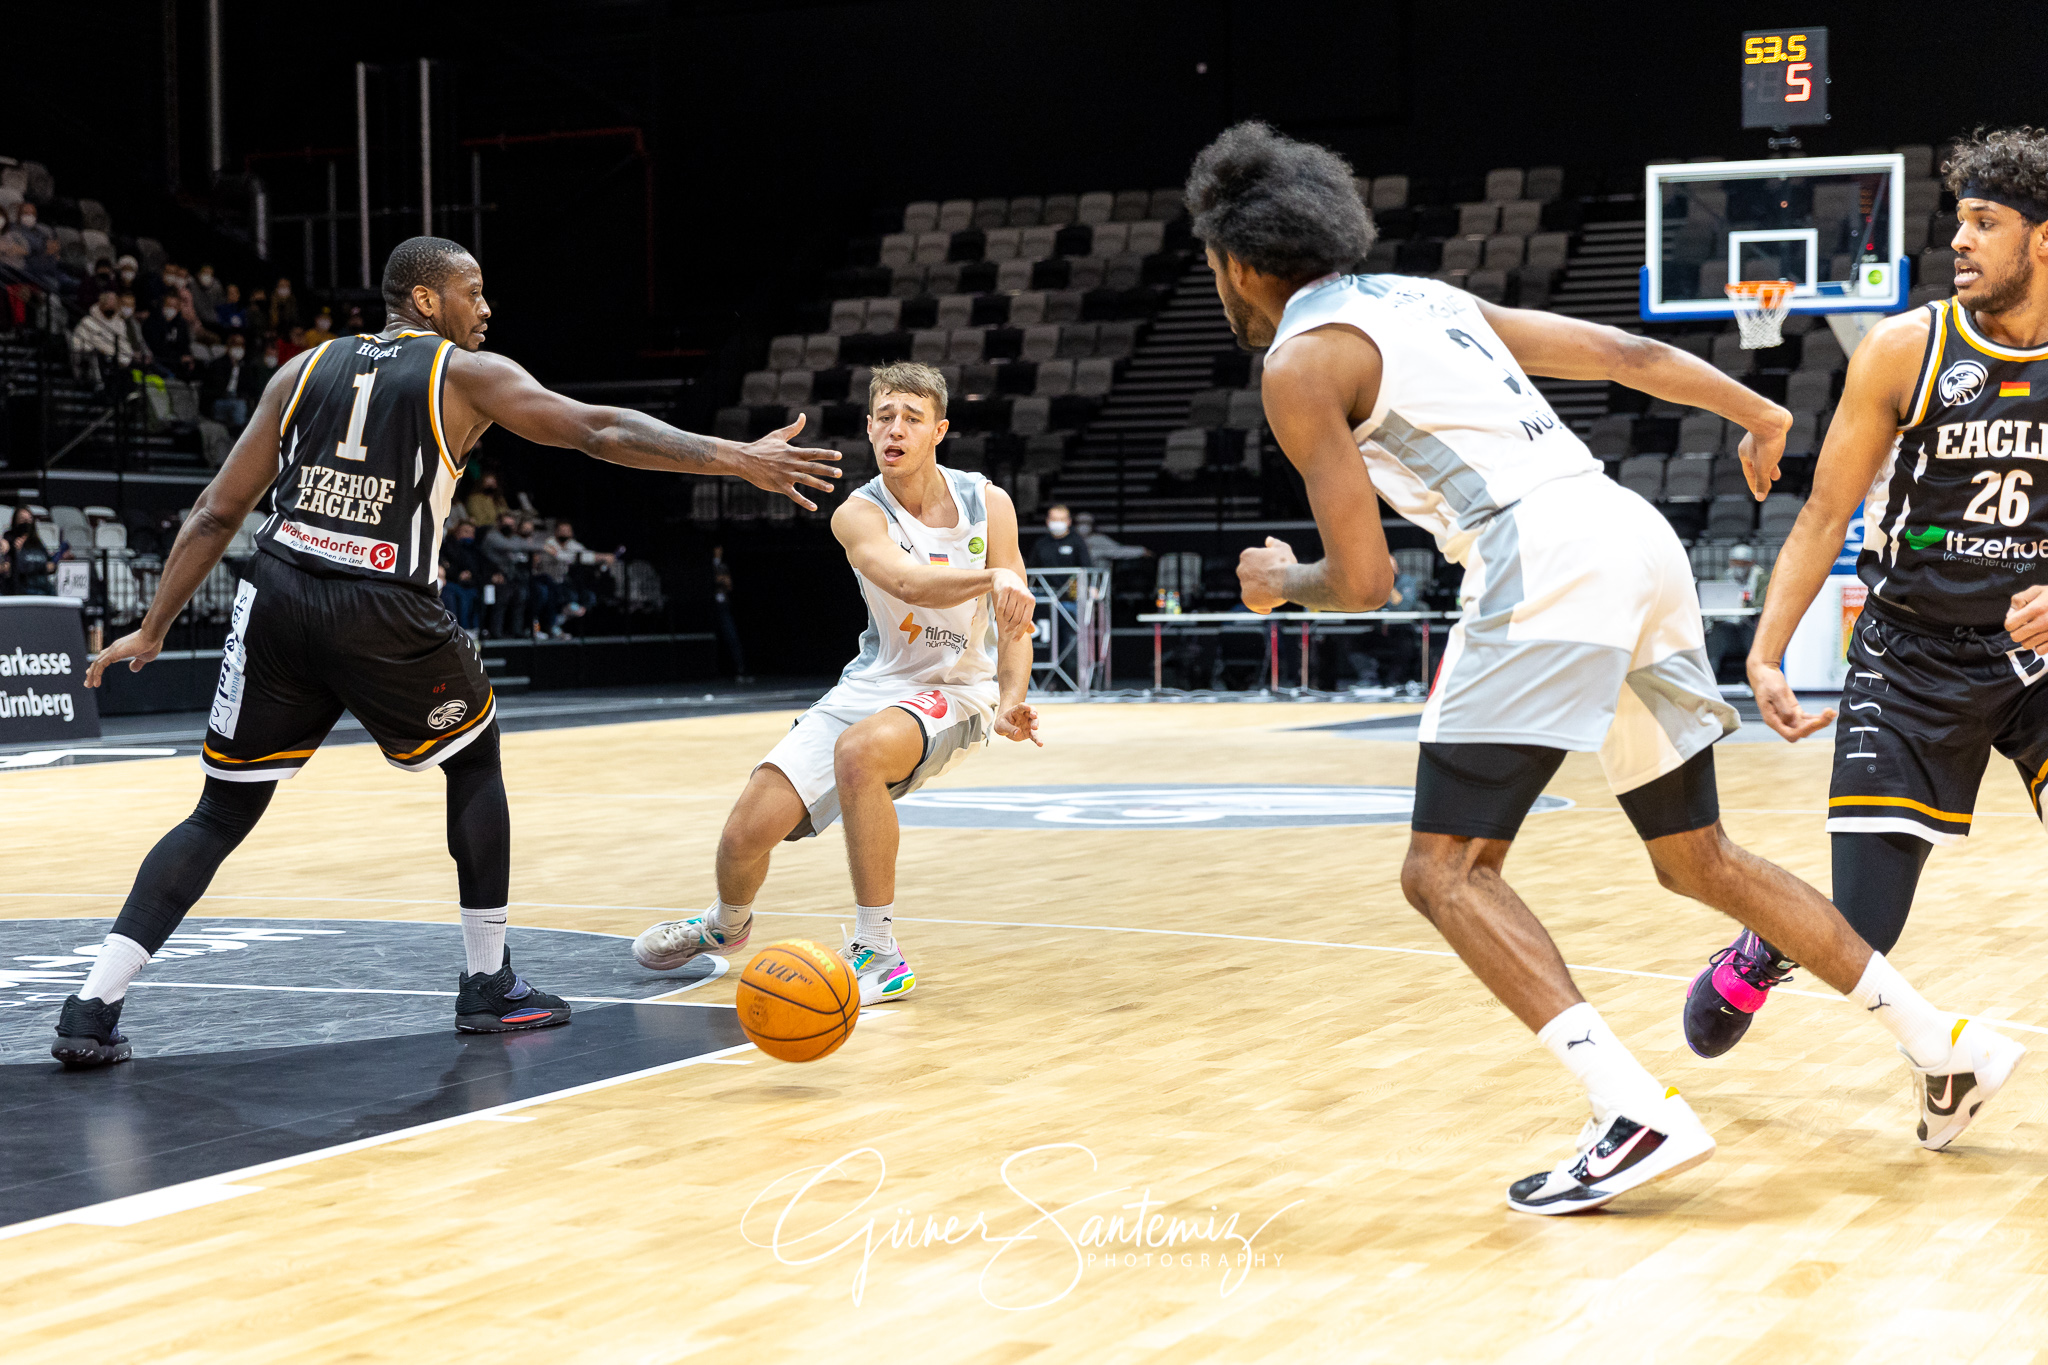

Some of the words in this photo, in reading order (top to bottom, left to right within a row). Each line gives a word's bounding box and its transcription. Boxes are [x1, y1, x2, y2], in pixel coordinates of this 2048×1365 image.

[1744, 34, 1807, 65] 53.5
[1784, 62, 1814, 103] 5
[335, 367, 378, 462] 1
[297, 465, 396, 504] ITZEHOE
[1962, 469, 2033, 528] 26
[295, 487, 384, 525] EAGLES
